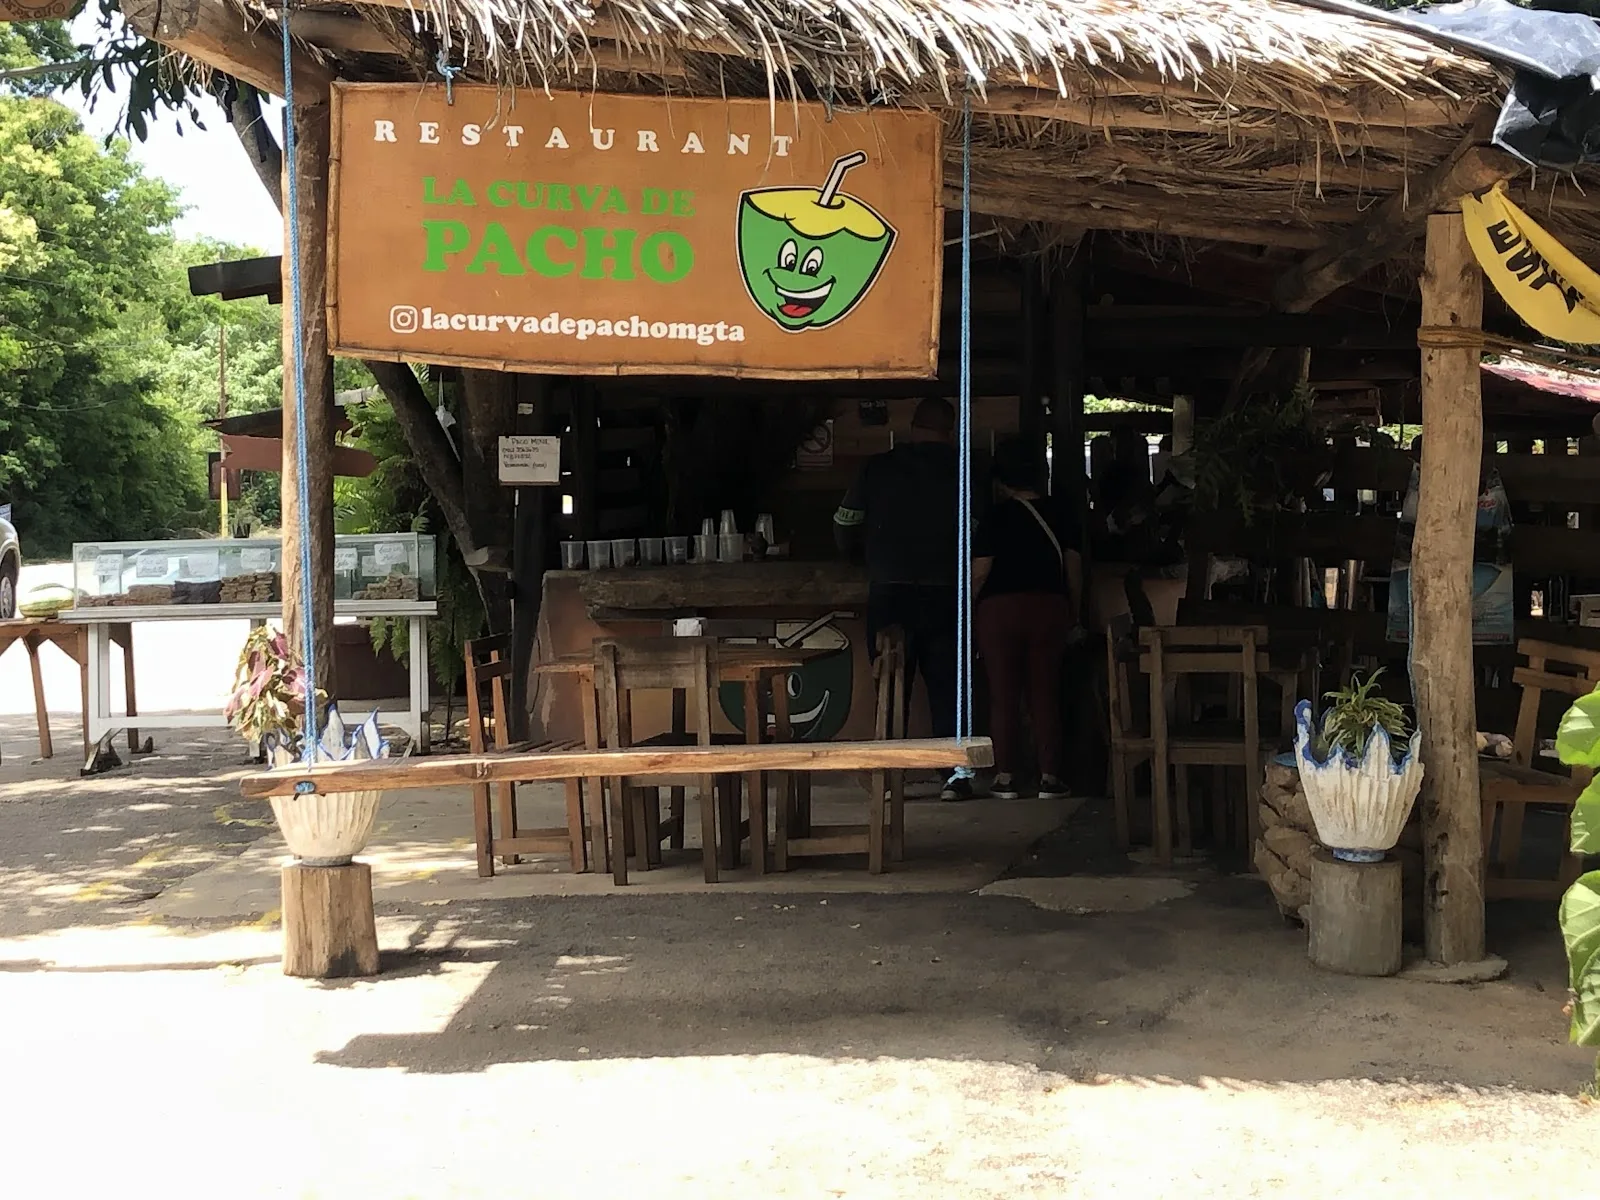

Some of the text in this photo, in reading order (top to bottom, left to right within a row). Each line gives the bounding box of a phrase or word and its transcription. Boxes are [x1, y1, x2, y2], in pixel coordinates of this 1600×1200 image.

[373, 120, 793, 157] RESTAURANT
[422, 176, 696, 217] LA CURVA DE
[421, 220, 695, 284] PACHO
[421, 306, 745, 346] lacurvadepachomgta
